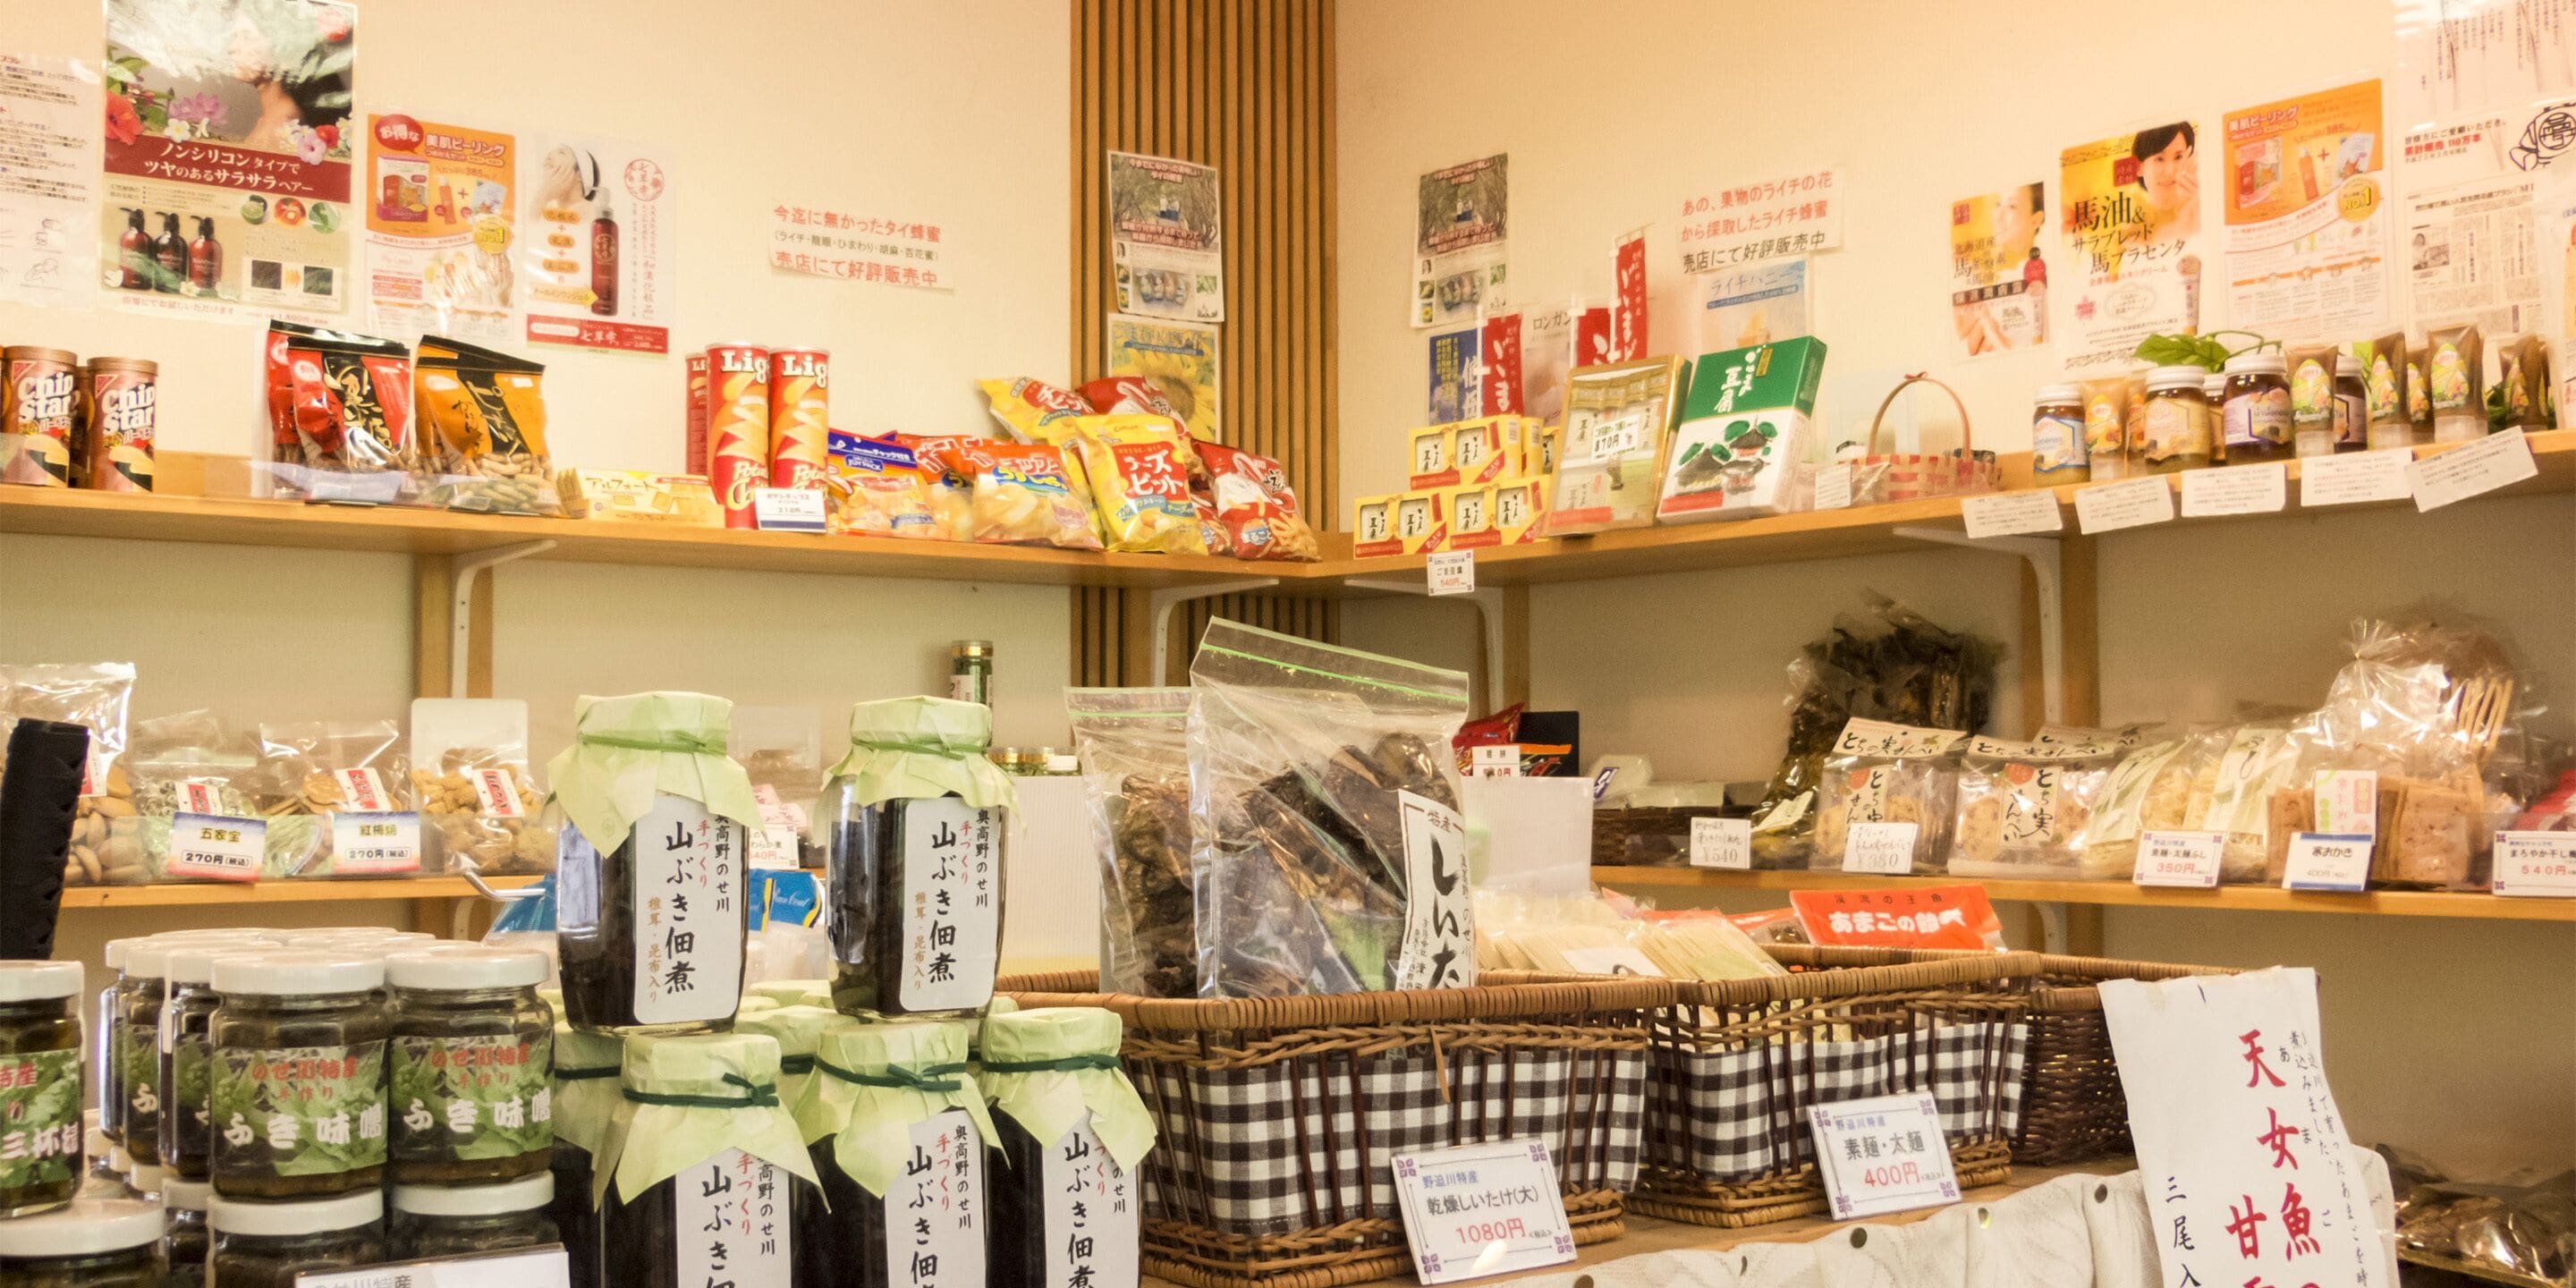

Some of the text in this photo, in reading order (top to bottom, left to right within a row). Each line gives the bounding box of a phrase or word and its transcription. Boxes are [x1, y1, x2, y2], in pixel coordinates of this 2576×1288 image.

[379, 123, 419, 142] お得な
[2228, 105, 2299, 133] 美肌ピーリング
[426, 134, 505, 157] 美肌ピーリング
[145, 161, 315, 193] ツヤのあるサラサラヘアー
[1682, 171, 1832, 216] あの、果物のライチの花
[774, 205, 941, 243] 今迄に無かったタイ蜂蜜
[1682, 199, 1828, 242] から採取したライチ蜂蜜
[2072, 191, 2145, 233] 馬油&
[1682, 231, 1826, 274] 売店にて好評販売中
[2072, 224, 2154, 253] サラブレッド
[775, 250, 938, 287] 売店にて好評販売中
[2089, 239, 2187, 275] 馬プラセンタ
[721, 352, 768, 384] Lig
[783, 356, 828, 387] Lig
[1129, 474, 1184, 496] ビット
[199, 827, 242, 843] 五家宝
[360, 824, 397, 836] 紅梅焼
[185, 852, 251, 868] 270円(税込)
[348, 850, 410, 859] 270円(税込)
[696, 819, 711, 889] 手づくり
[959, 819, 972, 884] 手づくり
[976, 808, 990, 909] 奥高野のせ川
[2157, 862, 2195, 875] 350円
[2312, 845, 2353, 859] 寒おかき
[2521, 864, 2566, 876] 540円
[665, 821, 696, 995] 山ぶき佃煮
[928, 821, 957, 983] 山ぶき佃煮
[1430, 832, 1461, 989] しいた
[647, 896, 662, 1004] 椎茸・昆布入り
[913, 893, 928, 990] 椎茸・昆布入り
[251, 1055, 358, 1083] の世川特産
[430, 1042, 530, 1070] の世川特産
[277, 1084, 335, 1104] 手作り
[458, 1071, 511, 1090] 手作り
[224, 1102, 383, 1149] ふき味噌
[402, 1087, 551, 1134] ふき味噌
[1844, 1131, 1925, 1161] 素麺・太麺
[2238, 1030, 2322, 1288] 天女魚
[936, 1132, 951, 1212] 手づくり
[953, 1124, 972, 1231] 奥高野のせ川
[1112, 1159, 1125, 1214] のせ川
[1422, 1171, 1479, 1189] 野迫川特産
[1865, 1162, 1920, 1188] 400円
[737, 1155, 753, 1236] 手づくり
[757, 1157, 775, 1257] 高野のせ川
[1427, 1185, 1539, 1216] 乾燥しいたけ(大)
[907, 1145, 939, 1288] 山ぶき佃
[1455, 1217, 1527, 1244] 1080円
[2224, 1195, 2276, 1288] 甘
